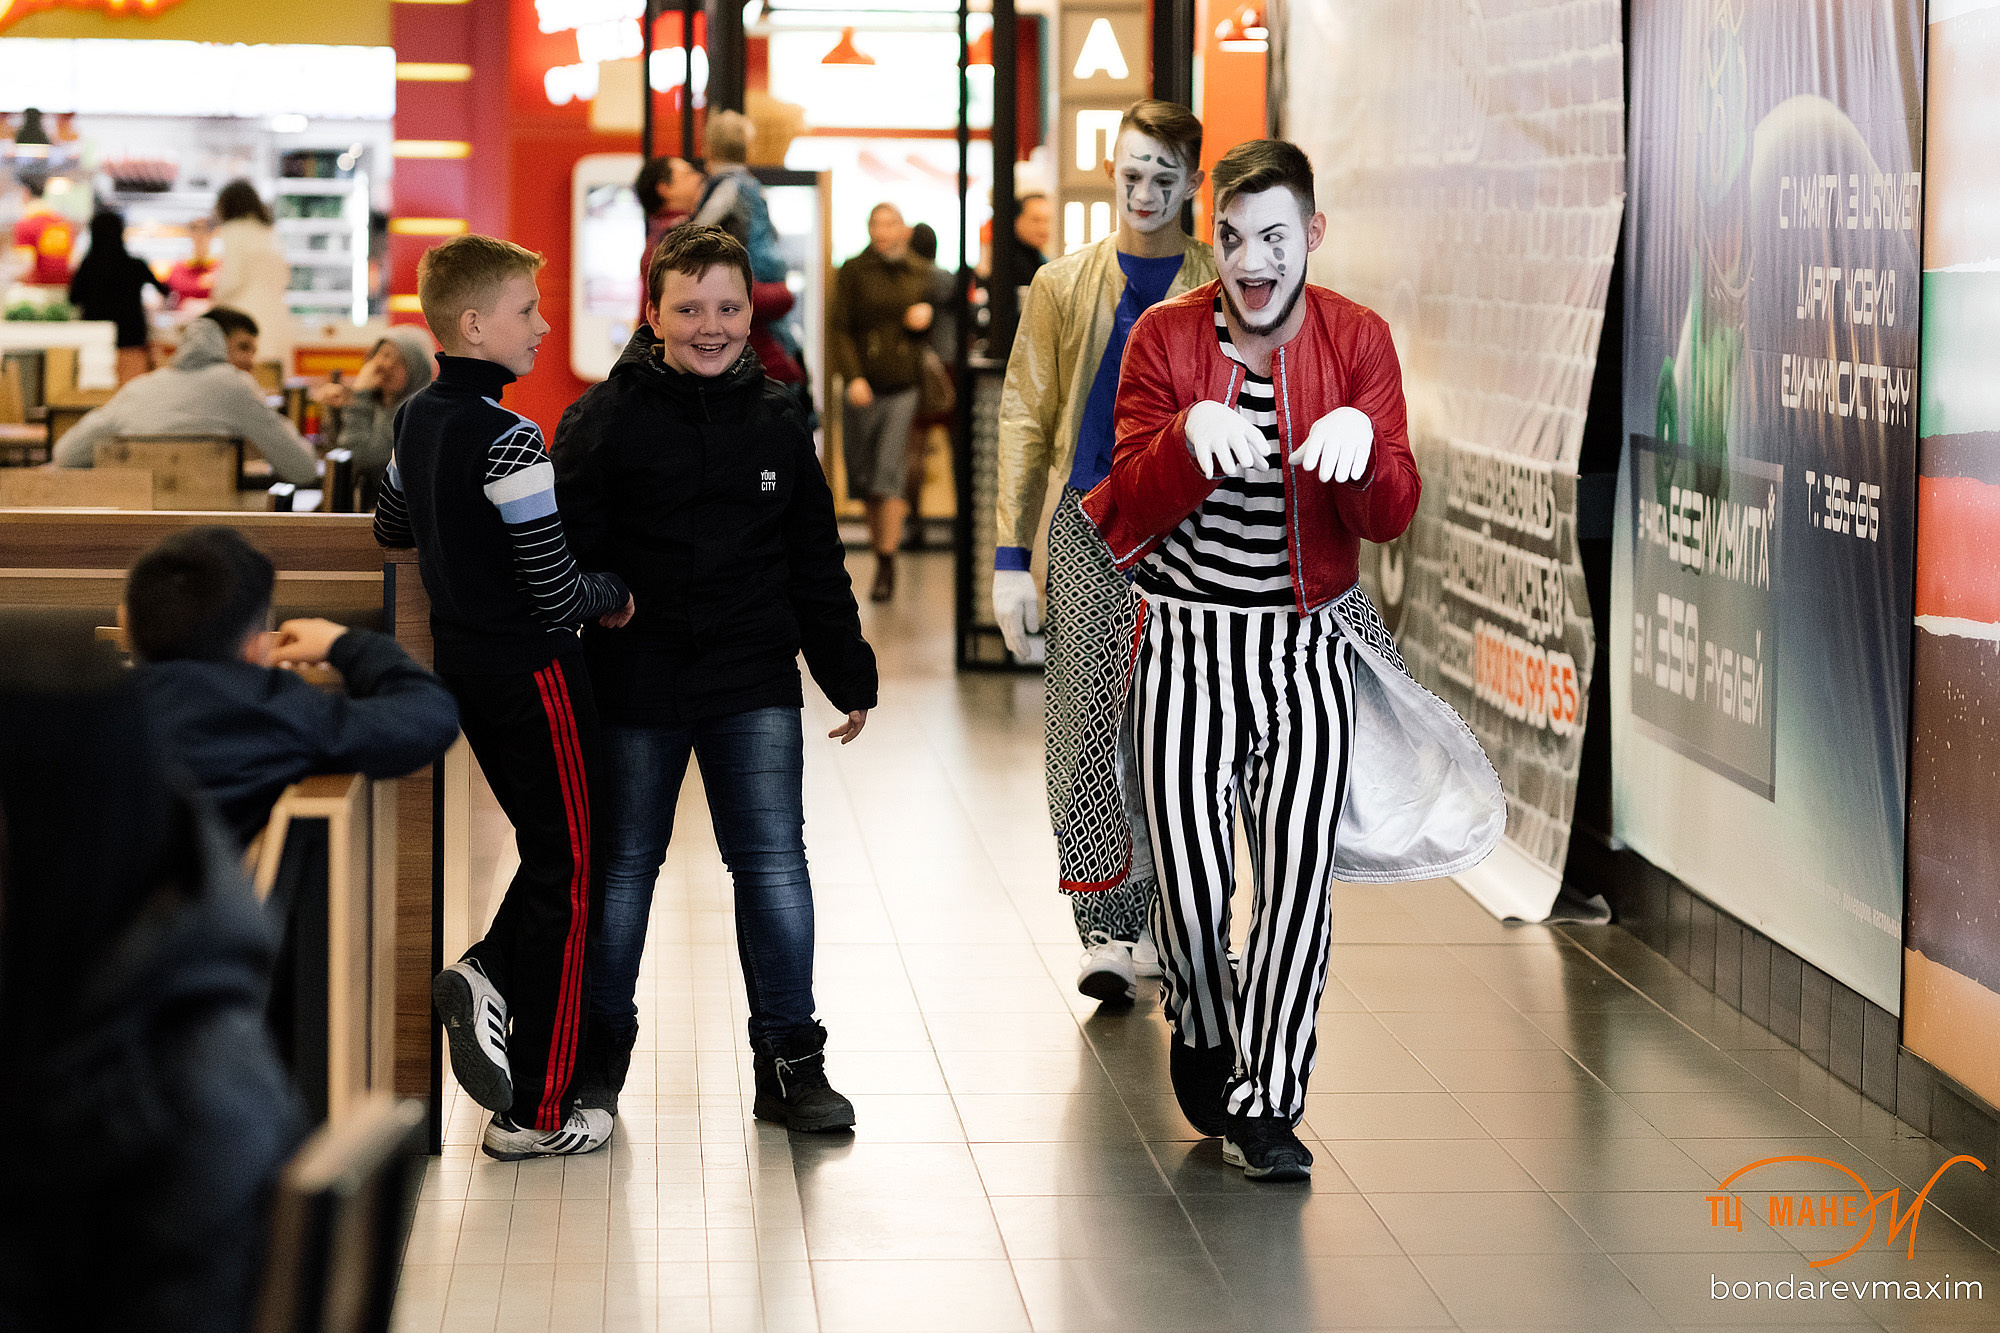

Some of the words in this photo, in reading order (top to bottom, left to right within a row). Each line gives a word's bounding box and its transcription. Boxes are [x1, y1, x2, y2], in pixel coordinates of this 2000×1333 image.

[1800, 172, 1844, 230] МАРТА
[1796, 263, 1842, 320] ДАРИТ
[1843, 267, 1896, 327] НОВУЮ
[1781, 352, 1836, 415] ЕДИНУЮ
[1837, 360, 1911, 428] СИСТЕМУ
[761, 481, 776, 491] CITY
[1655, 592, 1699, 701] 350
[1704, 629, 1764, 729] РУБЛЕЙ
[1550, 664, 1577, 724] 55
